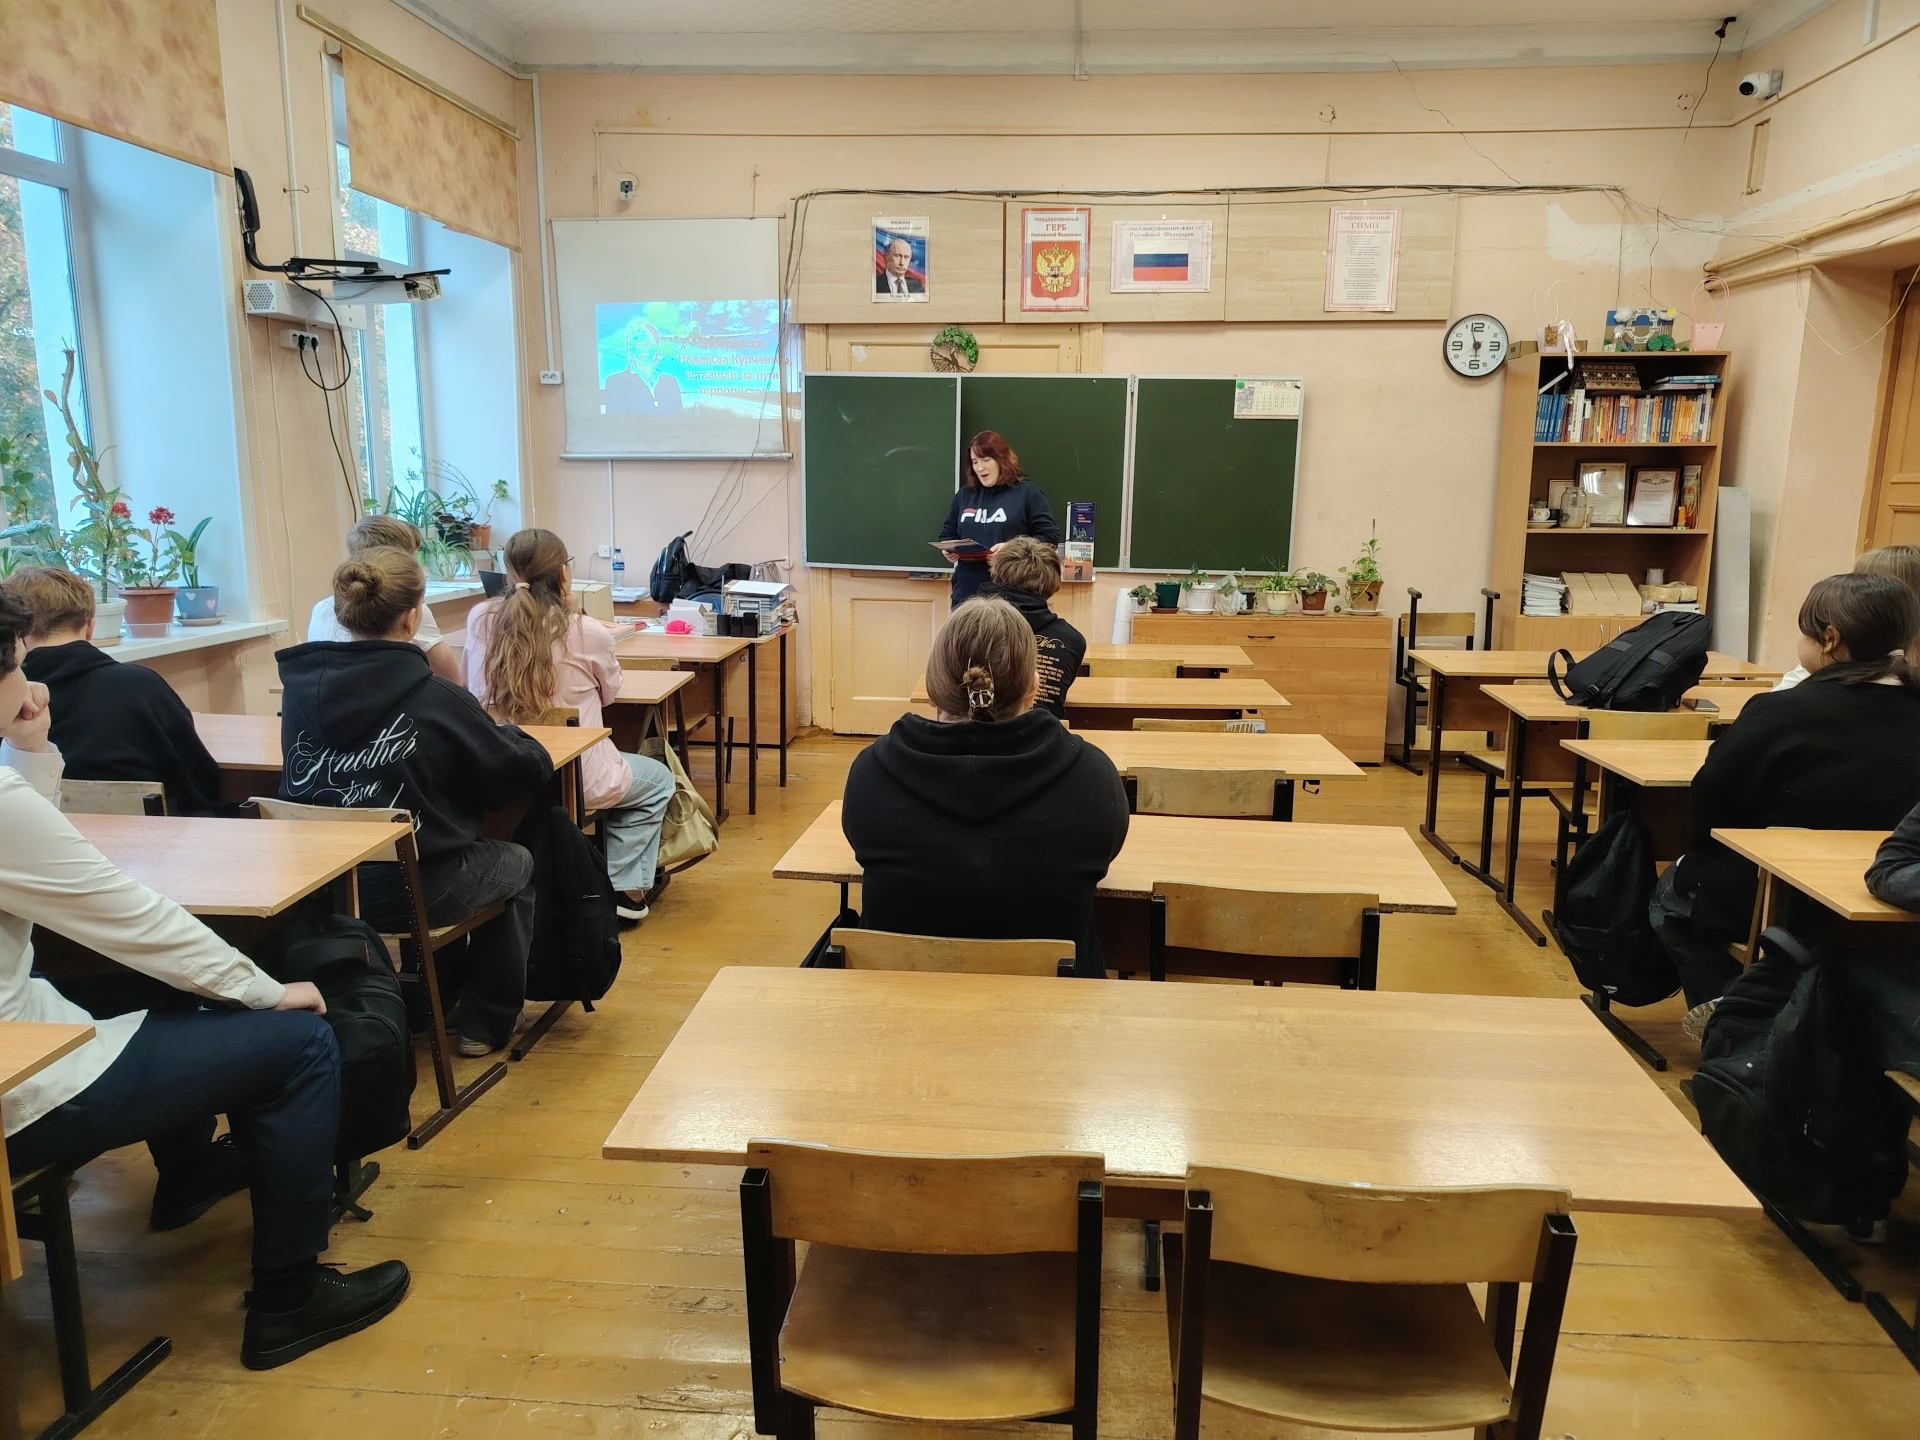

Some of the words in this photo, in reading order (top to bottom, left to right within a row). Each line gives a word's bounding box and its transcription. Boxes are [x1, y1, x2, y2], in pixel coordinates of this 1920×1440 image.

[1045, 223, 1067, 231] ГЕРБ
[1451, 340, 1463, 351] 9
[1488, 340, 1501, 352] 3
[678, 354, 729, 365] Надежда
[1468, 359, 1481, 370] 6
[685, 371, 739, 380] вставшая
[739, 371, 754, 380] на
[756, 371, 779, 382] пути
[960, 508, 1007, 524] FILA
[286, 712, 419, 797] Another
